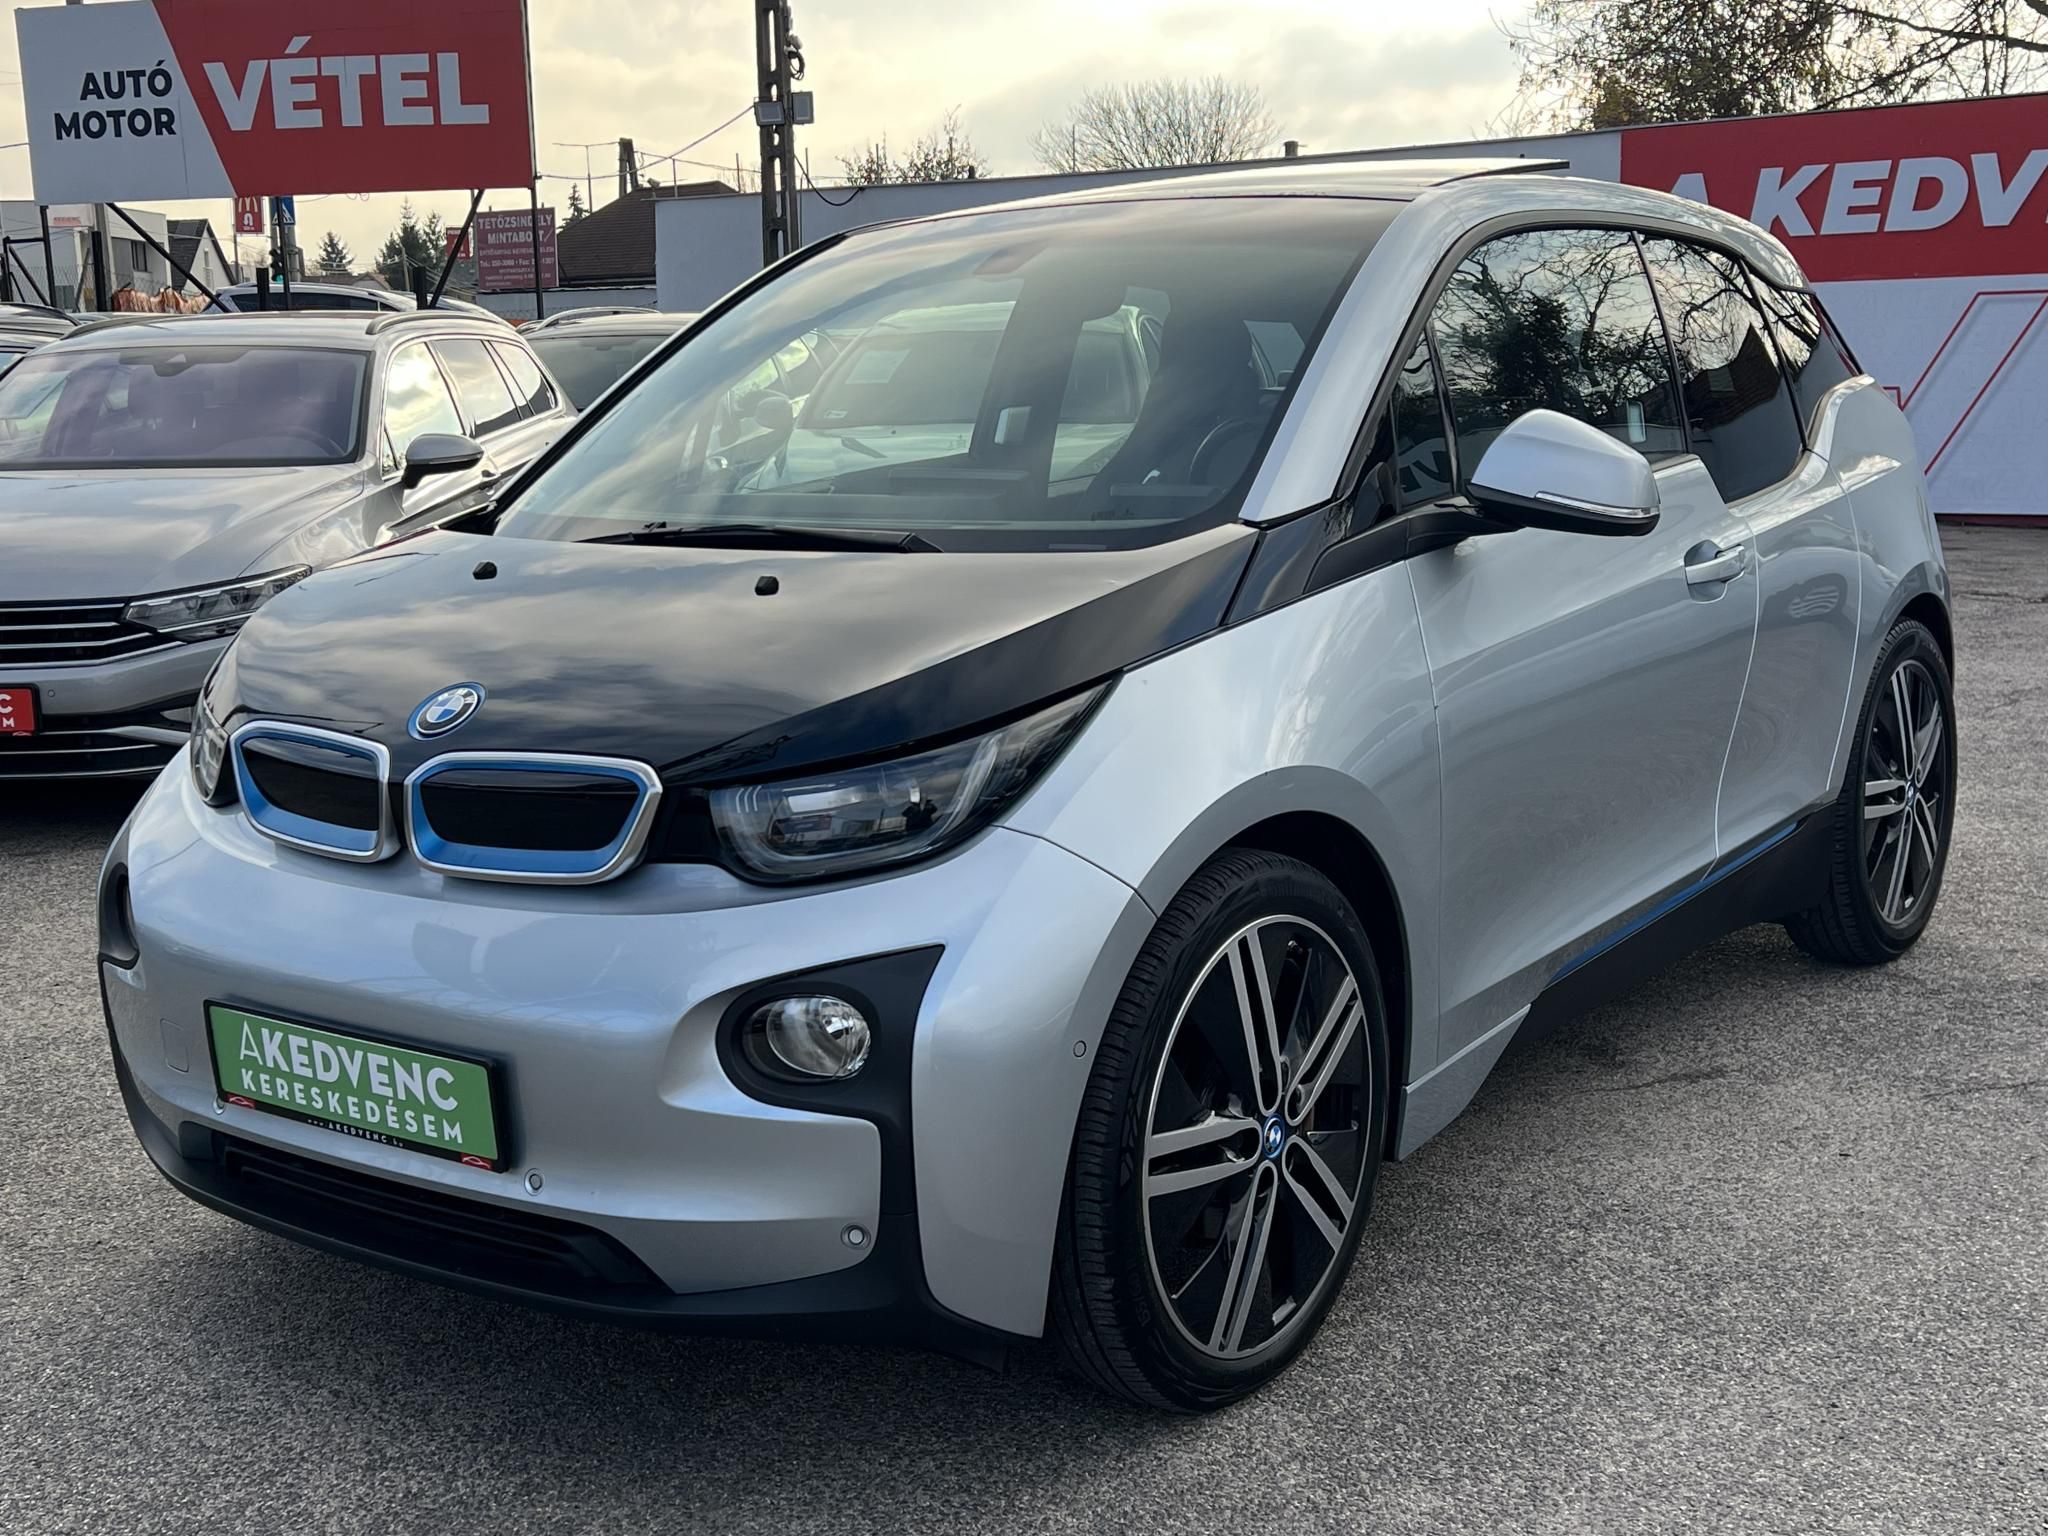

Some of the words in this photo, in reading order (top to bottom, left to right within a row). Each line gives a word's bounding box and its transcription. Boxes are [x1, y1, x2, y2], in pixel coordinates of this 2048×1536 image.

[80, 59, 173, 101] AUTÓ
[203, 35, 490, 131] VÉTEL
[54, 107, 176, 140] MOTOR
[1750, 149, 2048, 237] KEDV
[487, 230, 545, 245] MINTABOT
[241, 1067, 464, 1144] KERESKEDÉSEM
